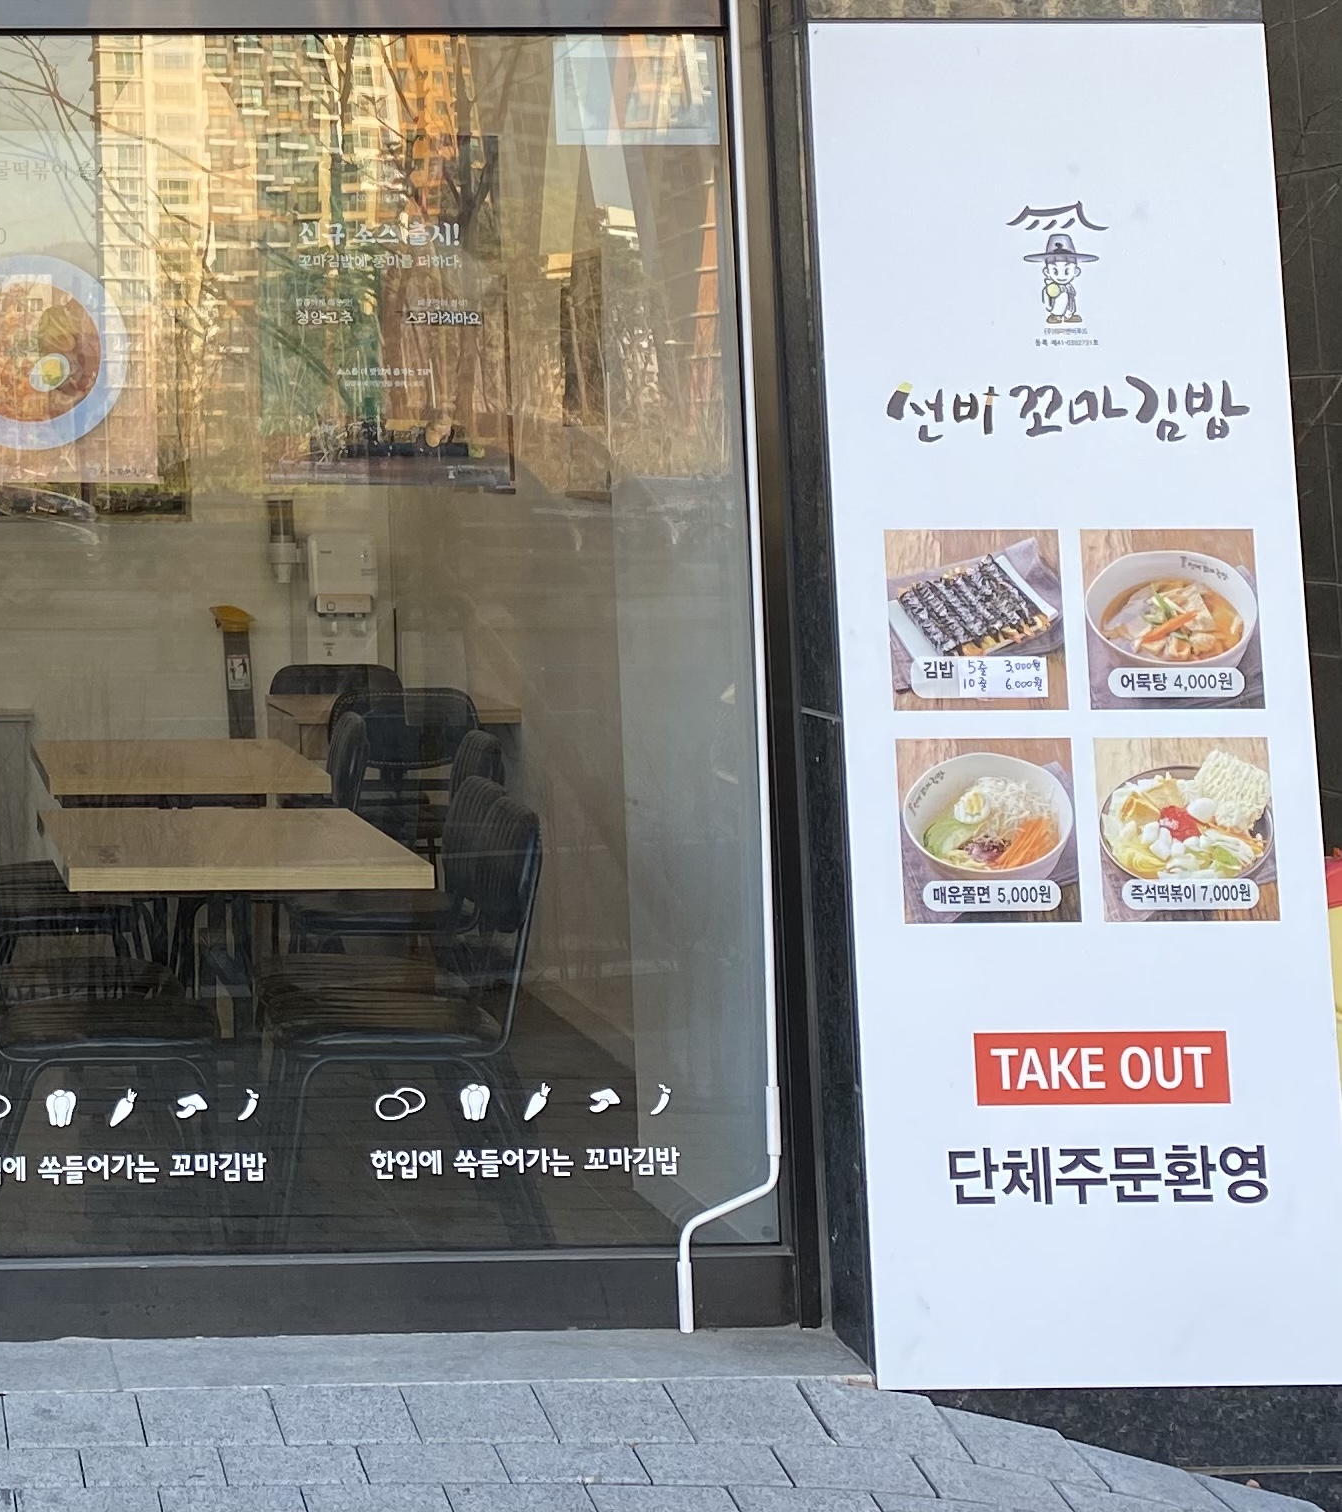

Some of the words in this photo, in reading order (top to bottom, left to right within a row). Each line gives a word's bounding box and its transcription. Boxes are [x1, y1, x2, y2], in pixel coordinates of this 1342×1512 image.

[299, 221, 346, 246] 신규
[354, 222, 400, 245] 소스
[408, 221, 461, 247] 출시!
[405, 311, 483, 326] 스리라차마요
[923, 660, 955, 679] 김밥
[1120, 672, 1167, 692] 어묵탕
[1173, 671, 1234, 693] 4,000원
[932, 885, 993, 905] 매운쫄면
[997, 884, 1053, 906] 5,000원
[1130, 882, 1197, 903] 즉석떡볶이
[1199, 882, 1253, 904] 7,000원
[989, 1047, 1107, 1091] TAKE
[1119, 1045, 1213, 1090] OUT
[36, 1153, 160, 1185] 쏙들어가는
[168, 1152, 267, 1182] 꼬마김밥
[369, 1148, 443, 1180] 한입에
[452, 1147, 575, 1179] 쏙들어가는
[582, 1146, 681, 1176] 꼬마김밥
[947, 1144, 1270, 1206] 단체주문환영
